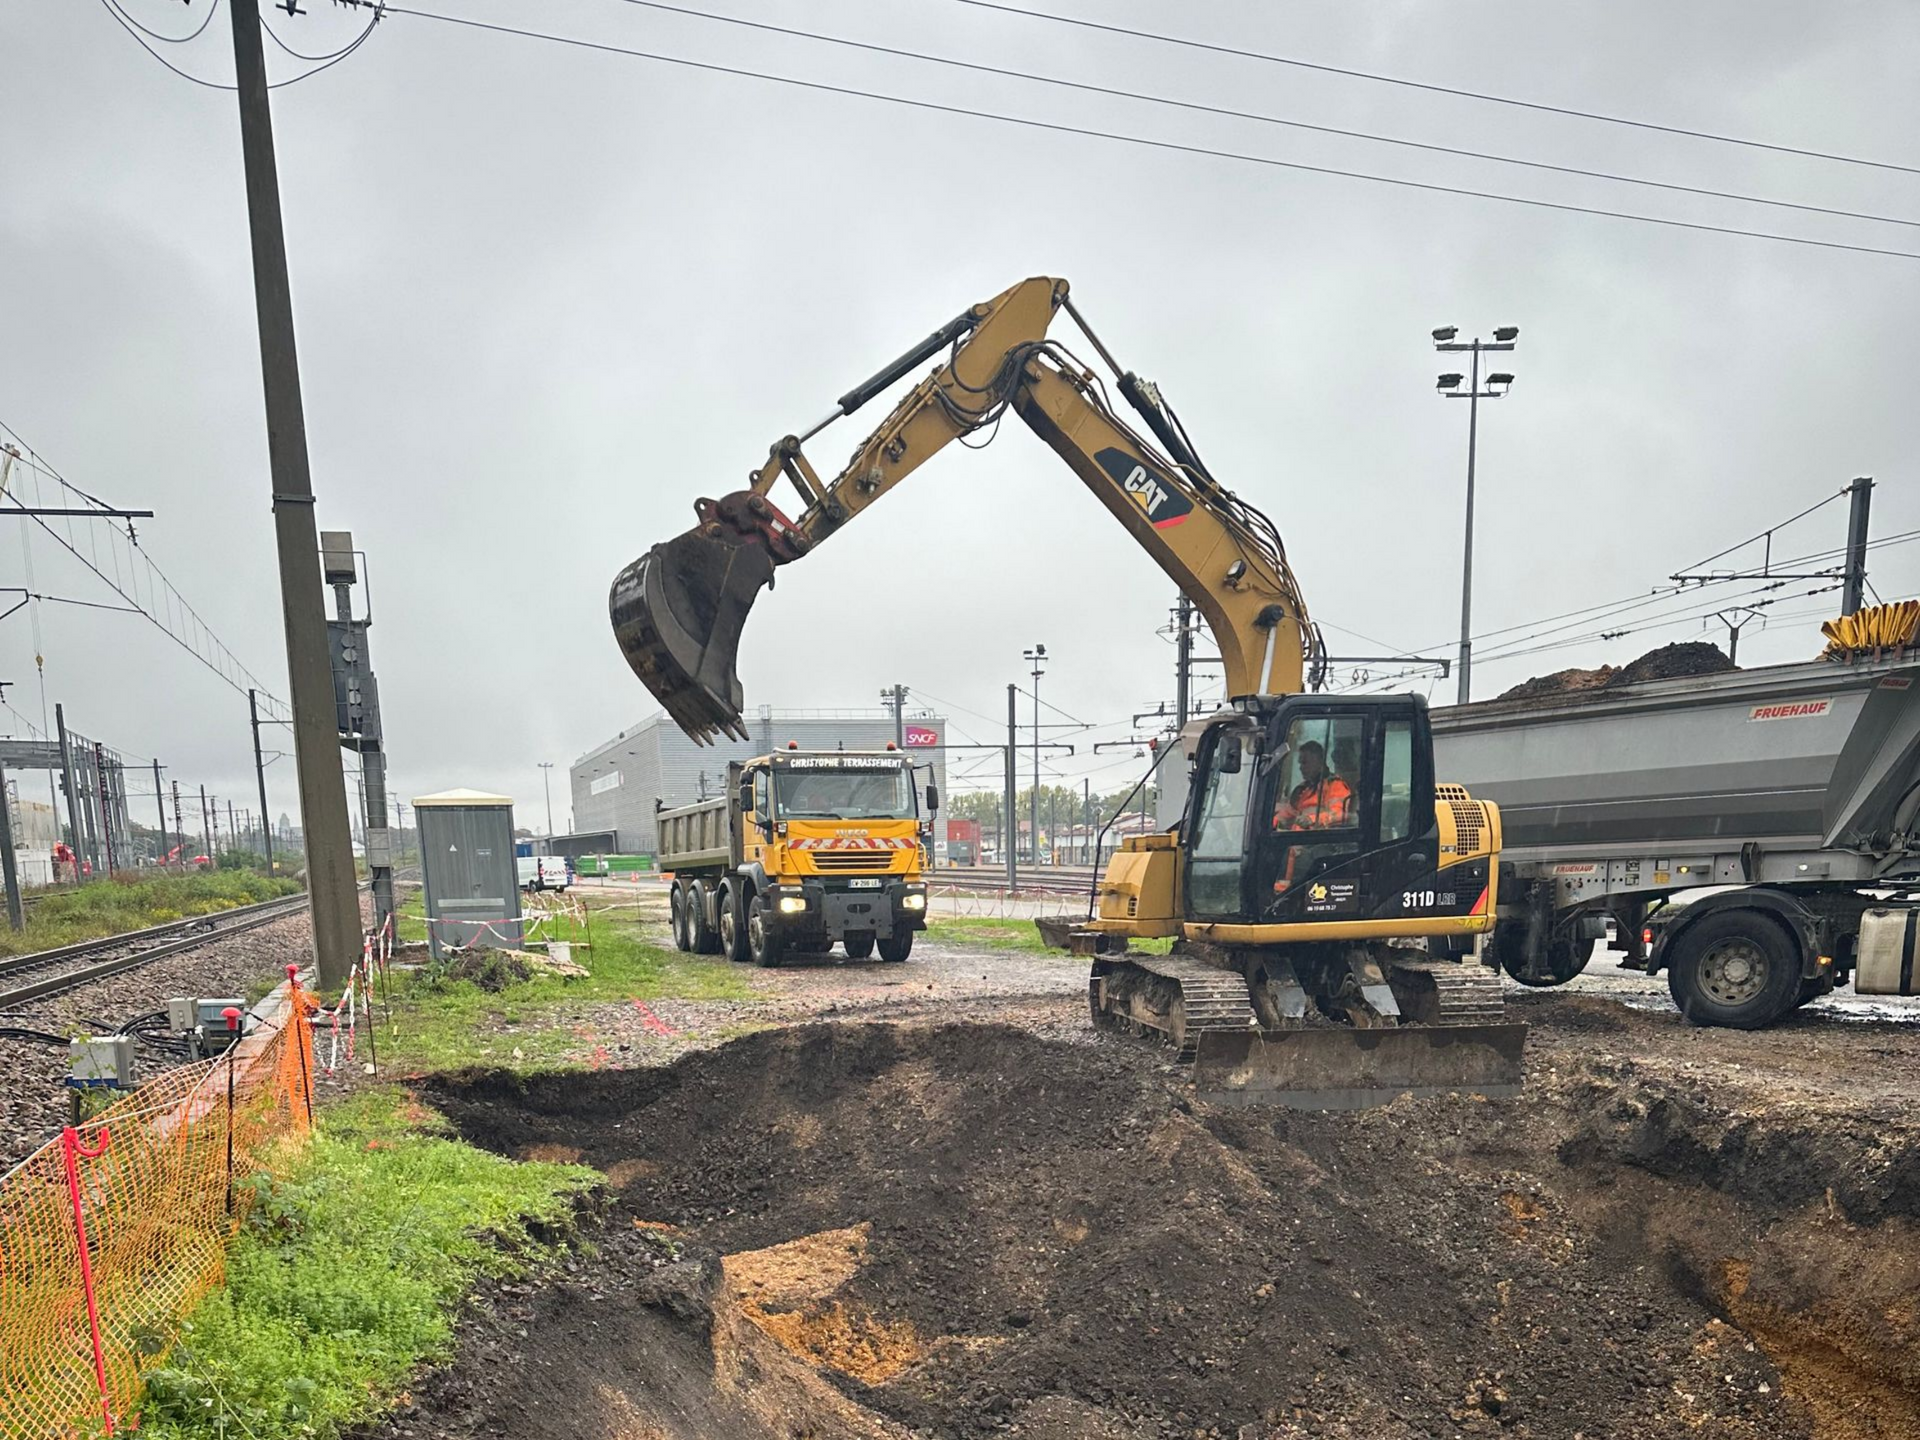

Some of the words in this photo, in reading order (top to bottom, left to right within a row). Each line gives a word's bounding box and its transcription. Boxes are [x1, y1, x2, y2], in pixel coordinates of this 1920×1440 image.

[1124, 465, 1169, 516] CAT
[1753, 702, 1828, 720] FRUEHAUF
[907, 733, 936, 744] SNCF
[790, 757, 839, 768] CHRISTOPHE
[842, 758, 903, 769] TERRASSEMENT
[835, 829, 868, 838] IVECO
[1555, 864, 1595, 873] FRUEHAUF
[1402, 890, 1435, 908] 311D
